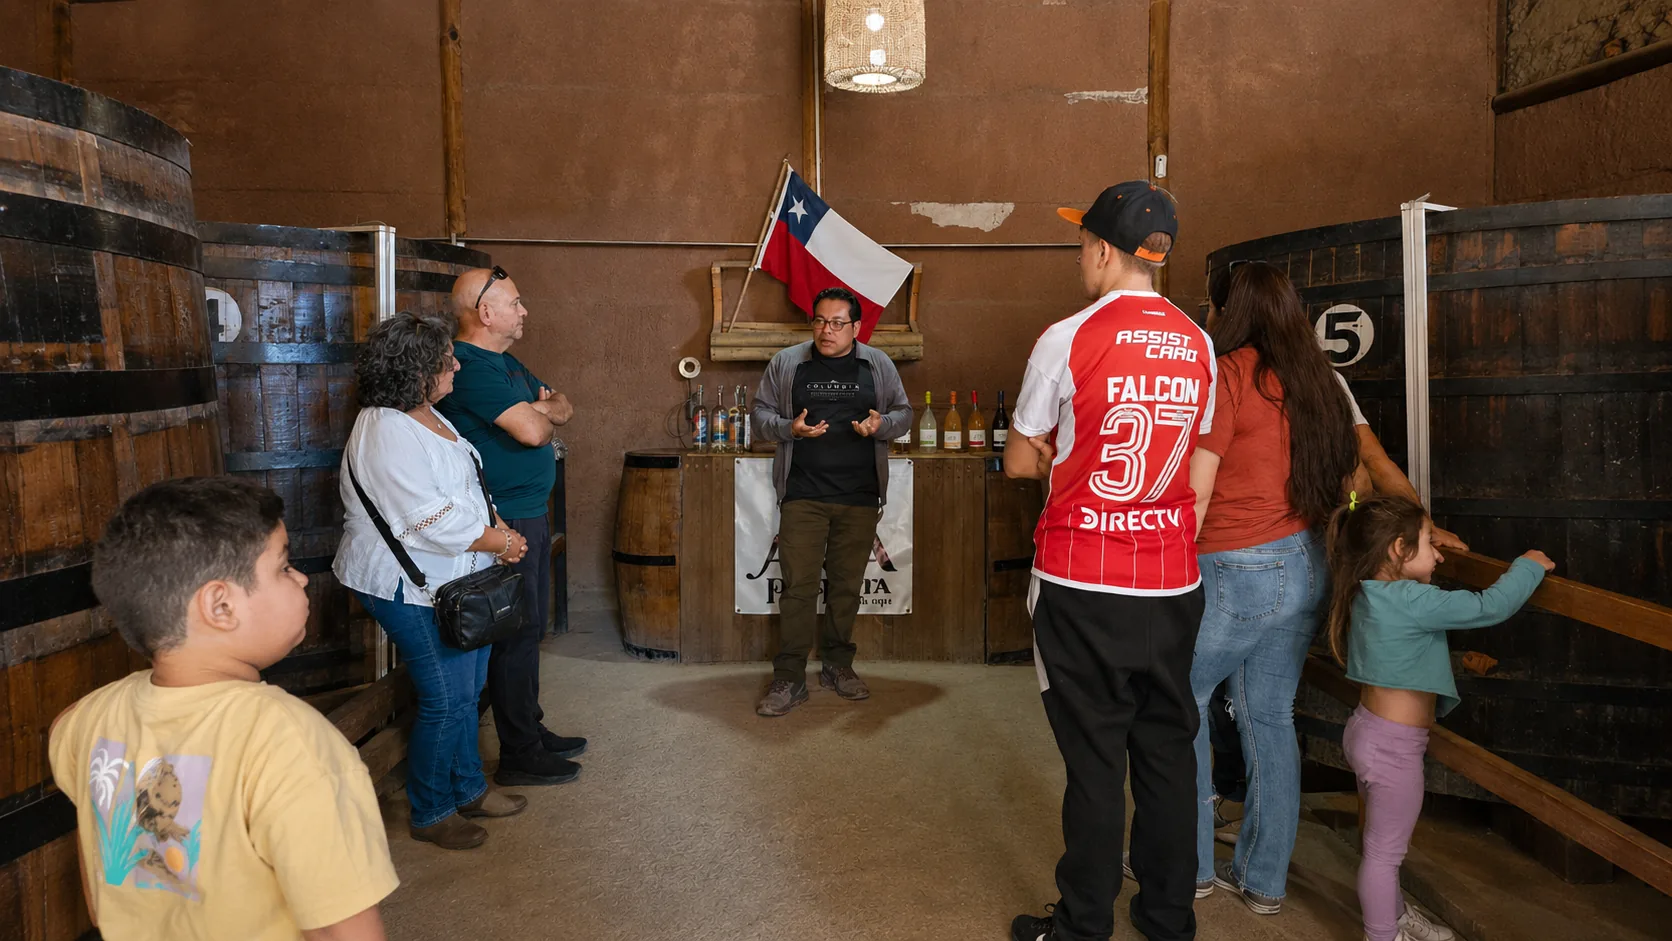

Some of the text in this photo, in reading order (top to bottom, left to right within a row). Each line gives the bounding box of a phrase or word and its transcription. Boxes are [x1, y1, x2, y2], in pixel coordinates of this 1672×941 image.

[1115, 330, 1192, 347] ASSIST
[1323, 311, 1362, 363] 5
[1107, 375, 1200, 404] FALCON
[1088, 403, 1199, 503] 37
[1080, 507, 1180, 531] DIRECTV
